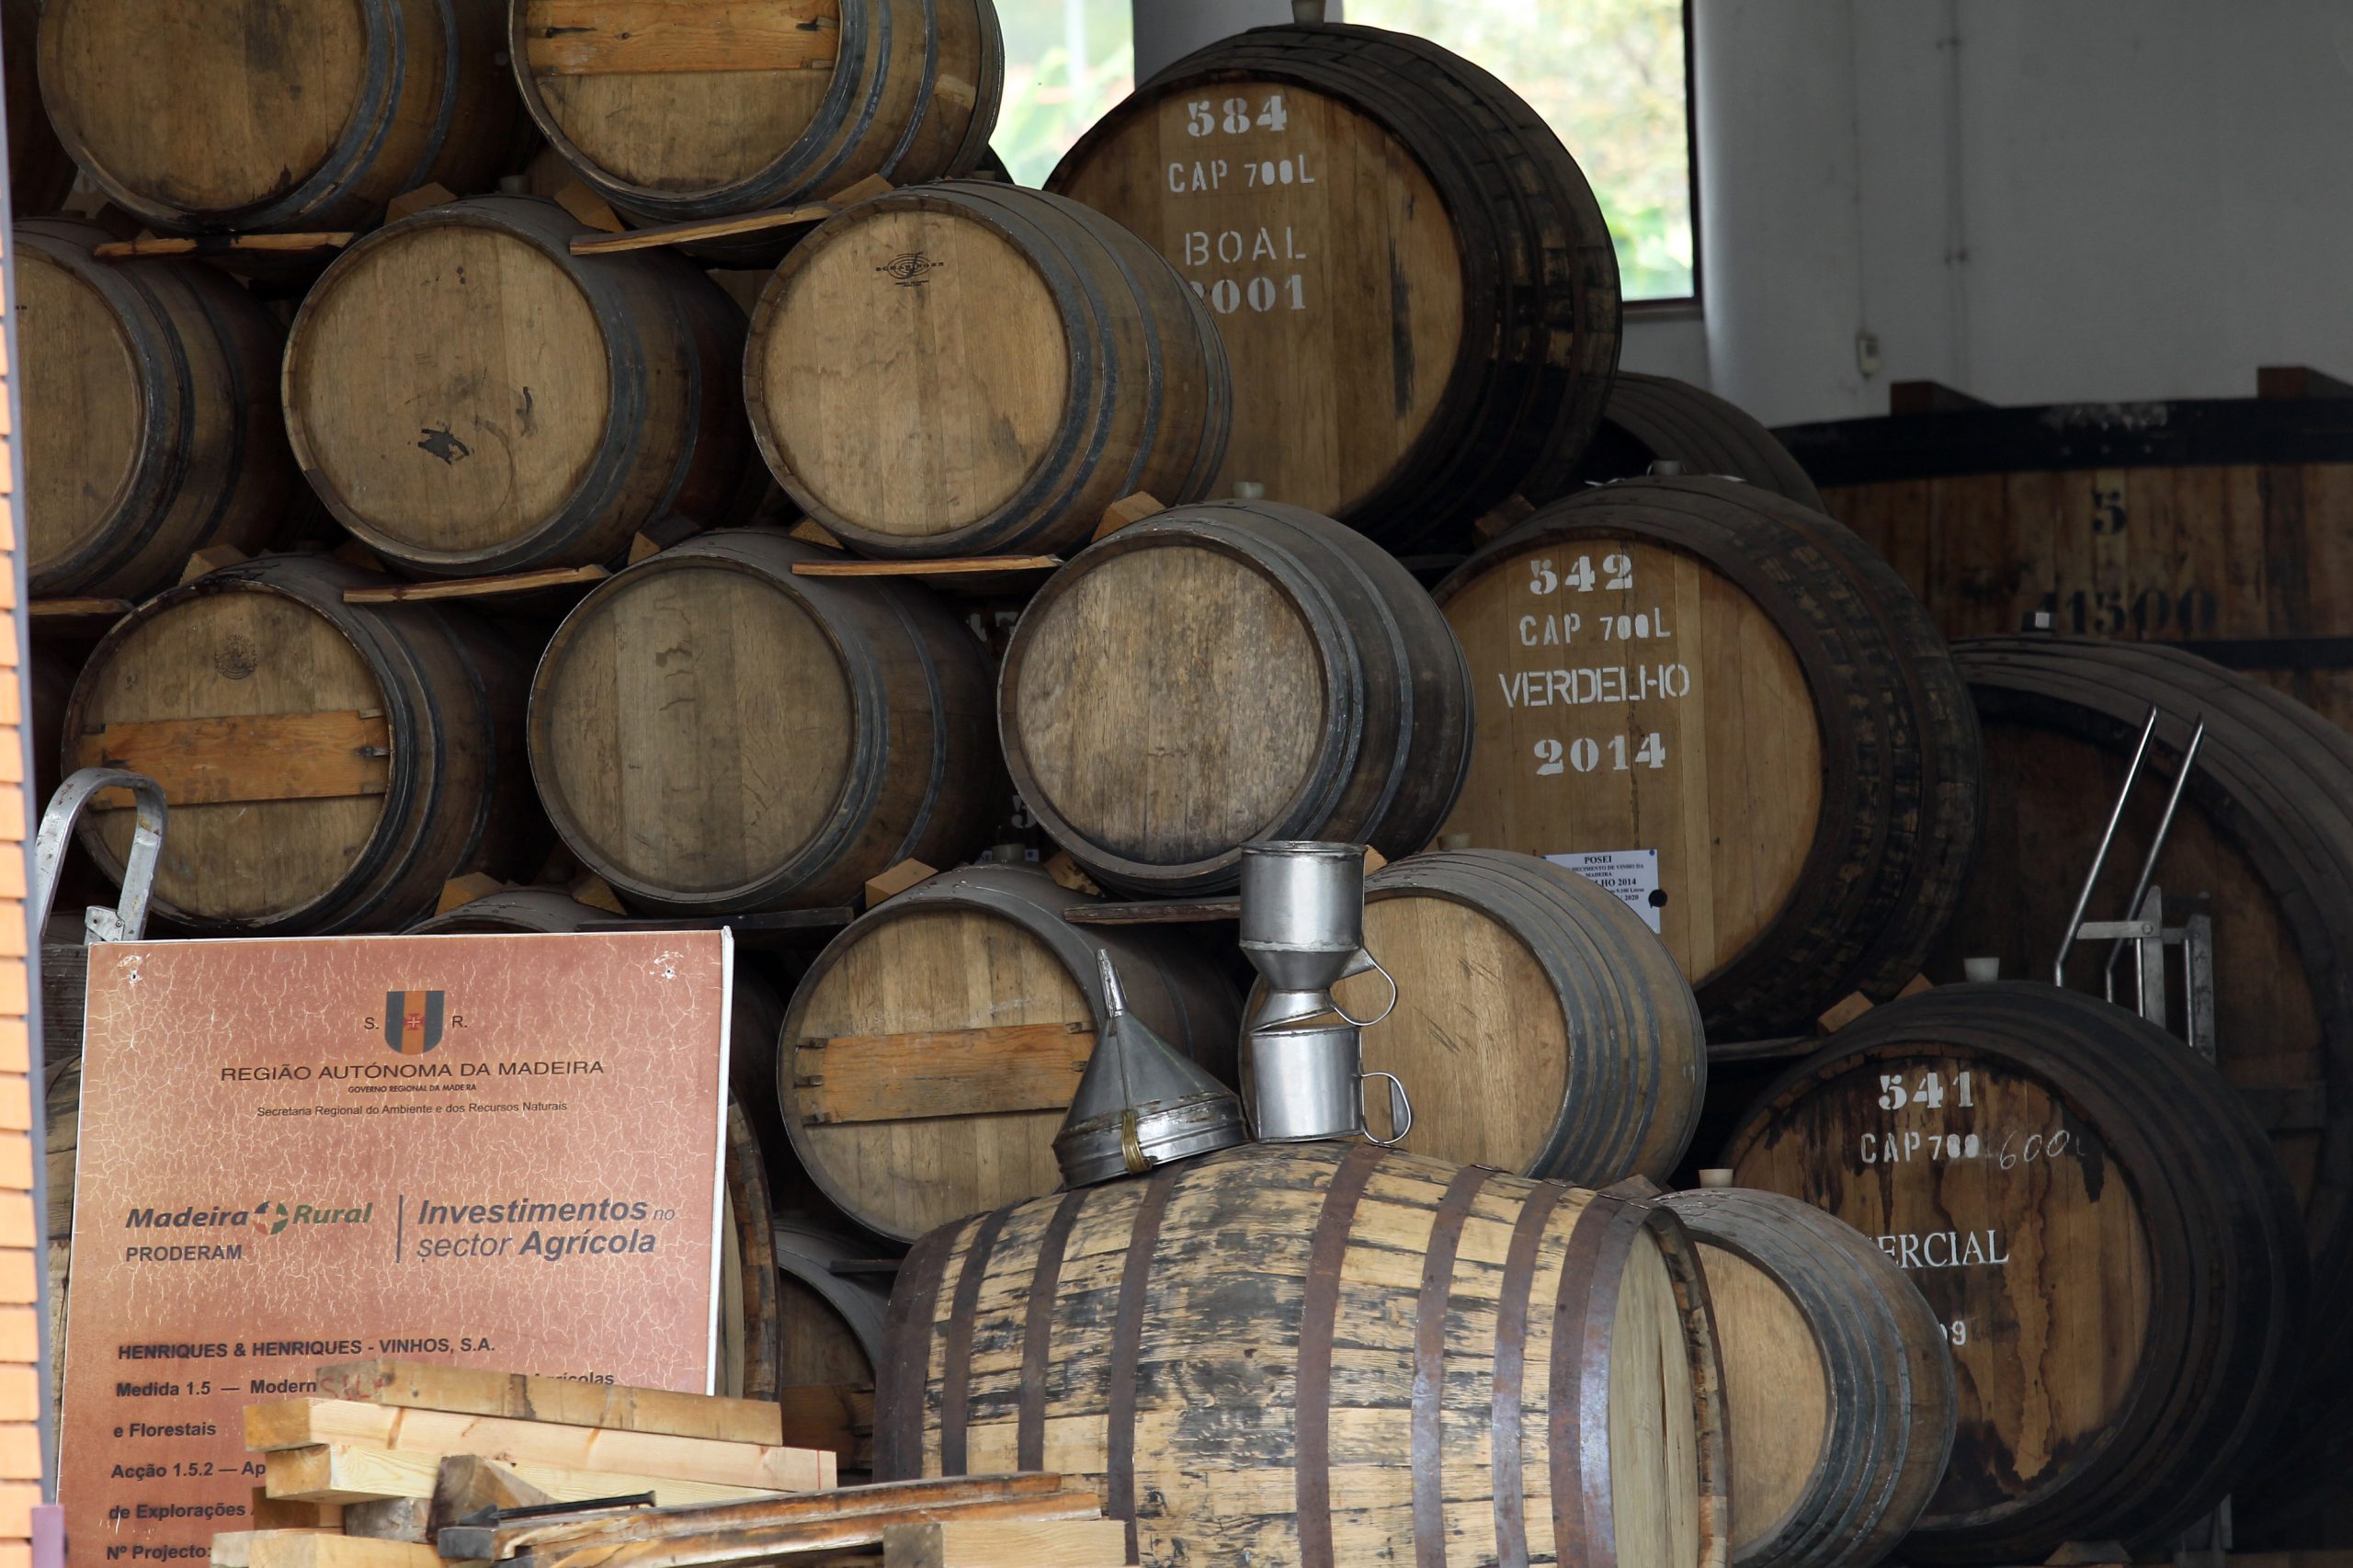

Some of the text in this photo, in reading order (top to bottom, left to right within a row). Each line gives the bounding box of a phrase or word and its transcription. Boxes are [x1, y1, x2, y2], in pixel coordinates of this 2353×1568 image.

[1188, 96, 1286, 137] 584
[1168, 153, 1314, 193] CAP 700L
[1185, 227, 1307, 266] BOAL
[2092, 488, 2127, 536] 5
[1529, 554, 1632, 595] 542
[1519, 608, 1671, 646] CAP 700L
[1499, 664, 1690, 708] VERDELHO
[1533, 733, 1665, 776] 2014
[1584, 855, 1612, 864] POSEI
[1618, 878, 1637, 887] 2014
[363, 1015, 468, 1030] S. R.
[221, 1062, 605, 1081] REGIÃO AUTÓNOMA DA MADEIRA
[1878, 1071, 1974, 1110] 541
[315, 1106, 362, 1118] Regional
[366, 1105, 380, 1115] do
[381, 1105, 432, 1115] Ambiente
[446, 1104, 465, 1113] dos
[469, 1103, 518, 1112] Recursos
[522, 1101, 567, 1111] Naturais
[1860, 1131, 1920, 1164] CAP
[125, 1202, 372, 1228] Madeira Rural
[418, 1198, 676, 1224] Investimentos no
[126, 1244, 242, 1262] PRODERAM
[416, 1229, 656, 1262] sector Agrícola
[1876, 1229, 2009, 1269] ERCIAL
[119, 1343, 228, 1359] HENRIQUES
[233, 1343, 245, 1357] &
[252, 1340, 362, 1357] HENRIQUES
[379, 1338, 454, 1354] VINHOS,
[460, 1337, 494, 1352] S.A.
[117, 1381, 179, 1396] Medida
[187, 1381, 210, 1395] 1.5
[114, 1422, 216, 1437] e Florestais
[111, 1463, 166, 1481] Acção
[173, 1462, 213, 1477] 1.5.2
[108, 1503, 245, 1521] de Explorações
[107, 1545, 127, 1561] Nº
